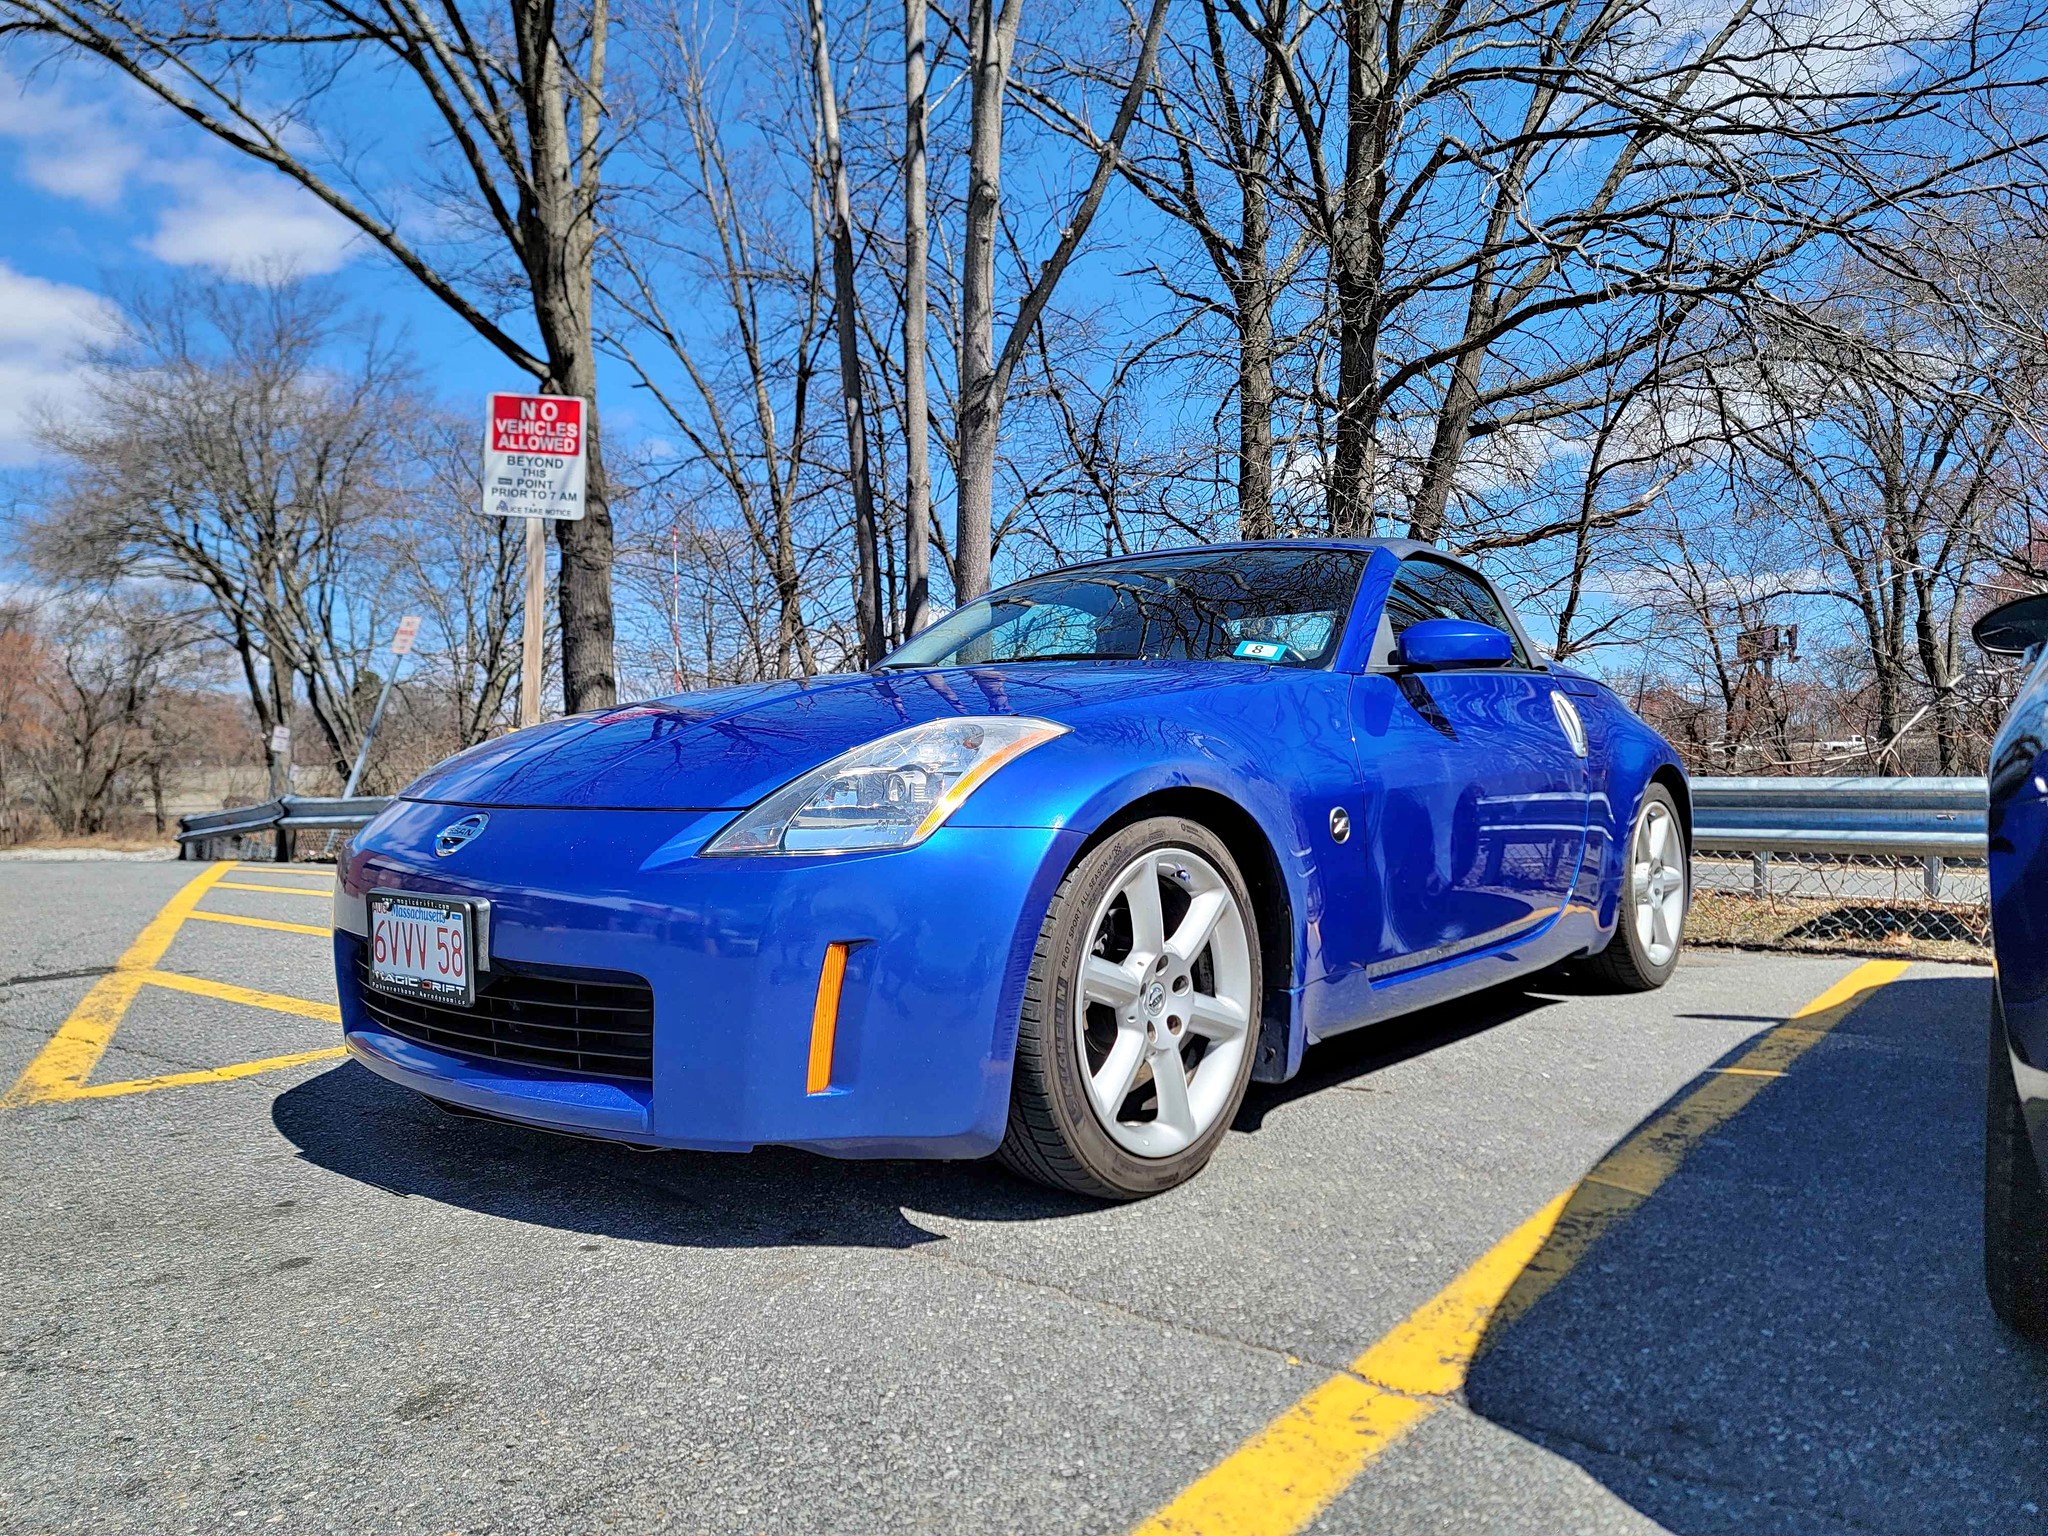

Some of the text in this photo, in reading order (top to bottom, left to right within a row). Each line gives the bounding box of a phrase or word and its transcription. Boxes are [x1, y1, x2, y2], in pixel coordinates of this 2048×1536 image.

[520, 400, 558, 421] NO
[495, 418, 578, 438] VEHICLES
[497, 434, 576, 453] ALLOWED
[507, 455, 564, 469] BEYOND
[522, 468, 546, 478] THIS
[517, 478, 554, 490] POINT
[491, 487, 577, 501] PRIOR TO 7 AM
[496, 504, 572, 517] PLICE TAKE NOTICE
[1251, 644, 1264, 654] 8
[391, 904, 446, 924] Massachusetts
[1061, 942, 1072, 969] PILOT
[1068, 908, 1082, 939] SPORT
[1080, 891, 1089, 908] ALL
[1088, 860, 1109, 888] SEASON
[374, 920, 463, 978] 6VVV 58
[421, 979, 465, 996] DRIFT
